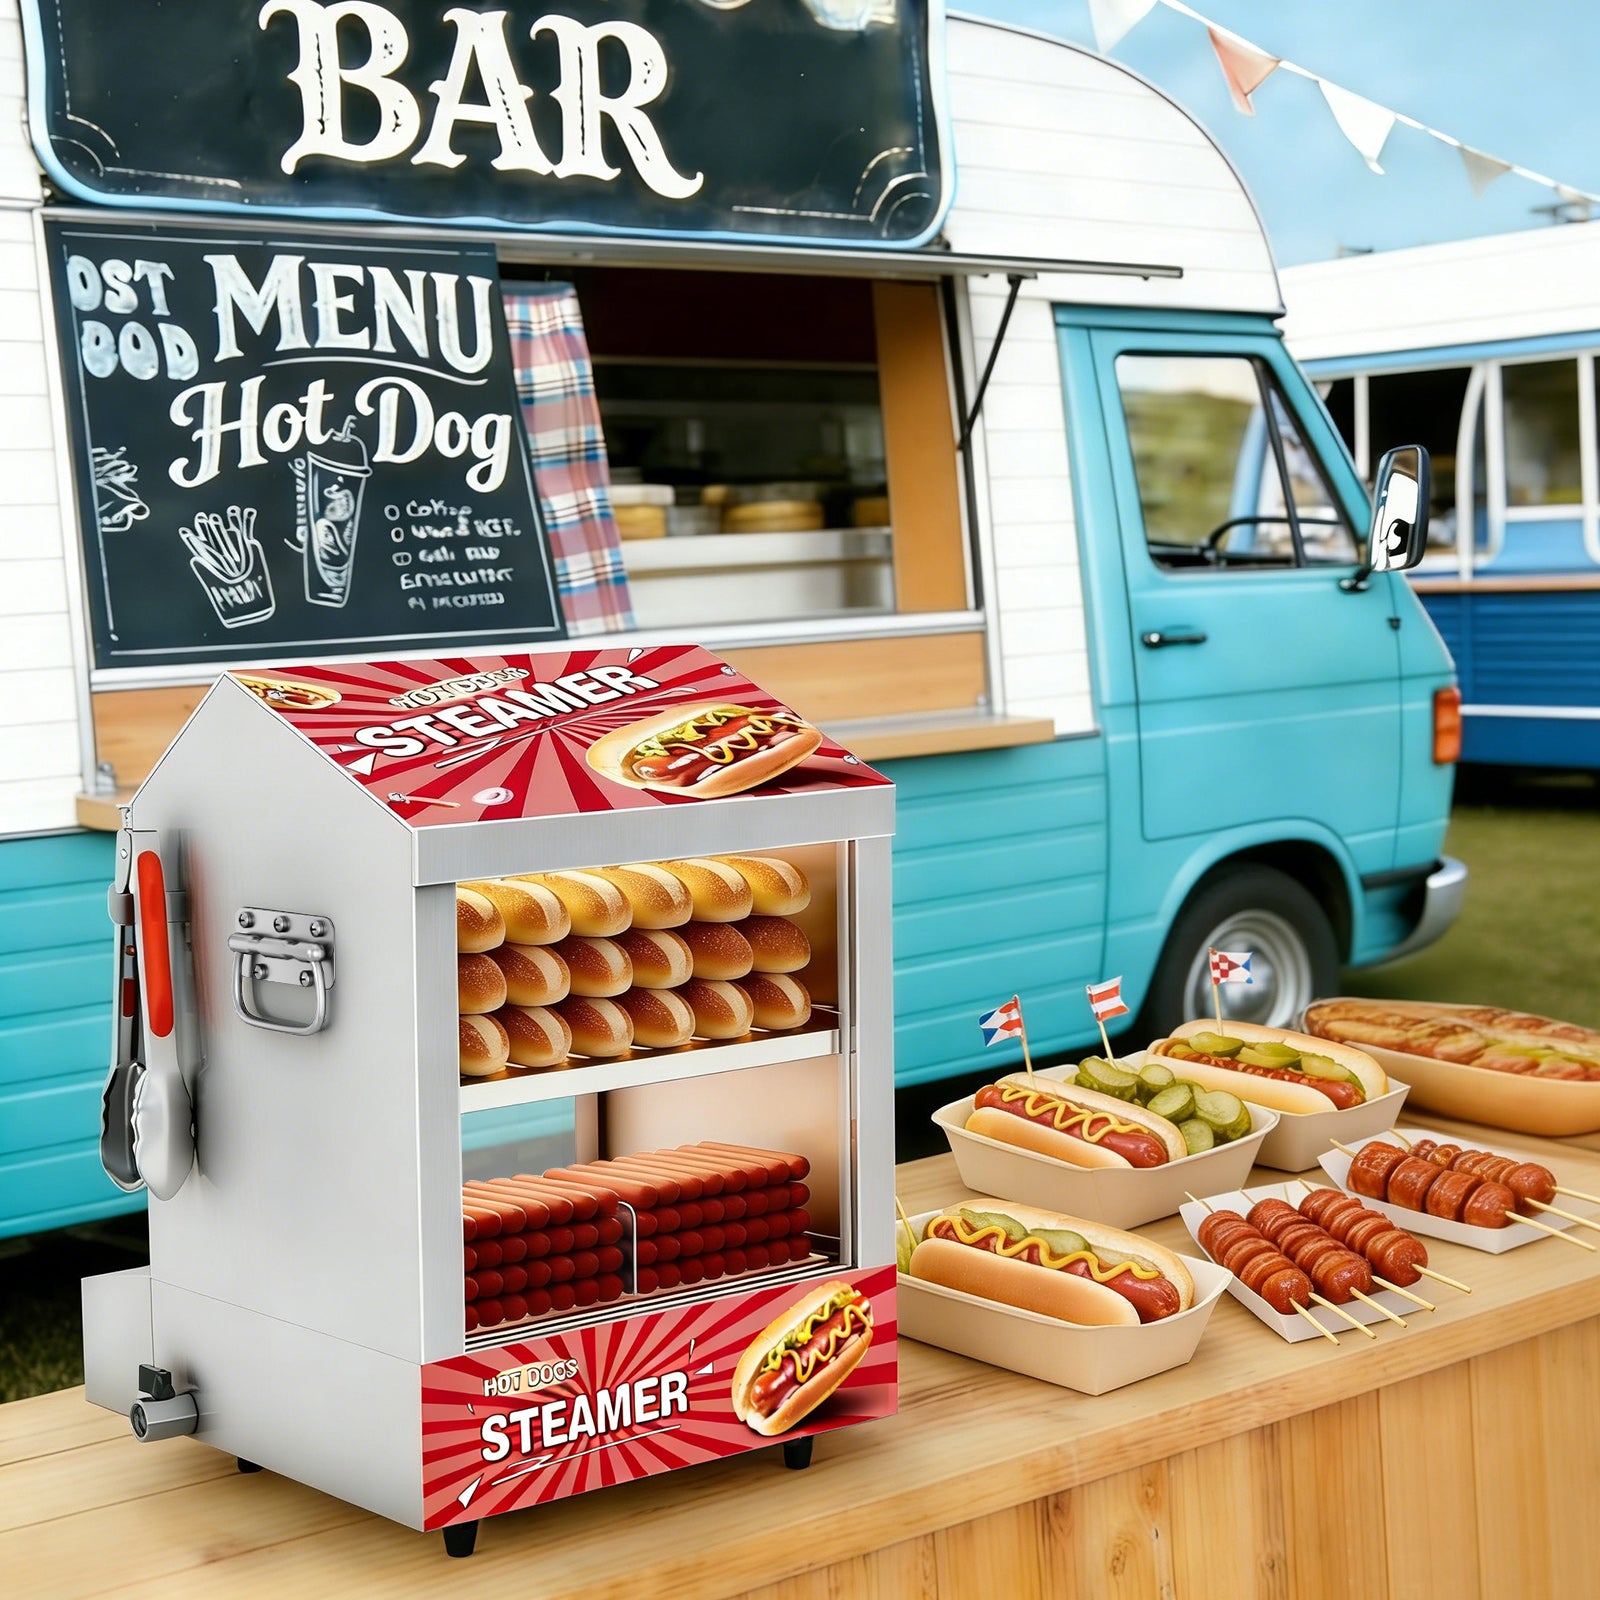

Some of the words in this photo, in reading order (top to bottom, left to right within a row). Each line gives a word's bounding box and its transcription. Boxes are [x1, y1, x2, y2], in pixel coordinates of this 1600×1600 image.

[259, 0, 703, 198] BAR
[203, 254, 493, 374] MENU
[169, 376, 334, 487] Hot
[355, 376, 512, 493] Dog
[354, 665, 660, 757] STEAMER
[481, 1370, 689, 1462] STEAMER
[483, 1371, 521, 1397] HOT
